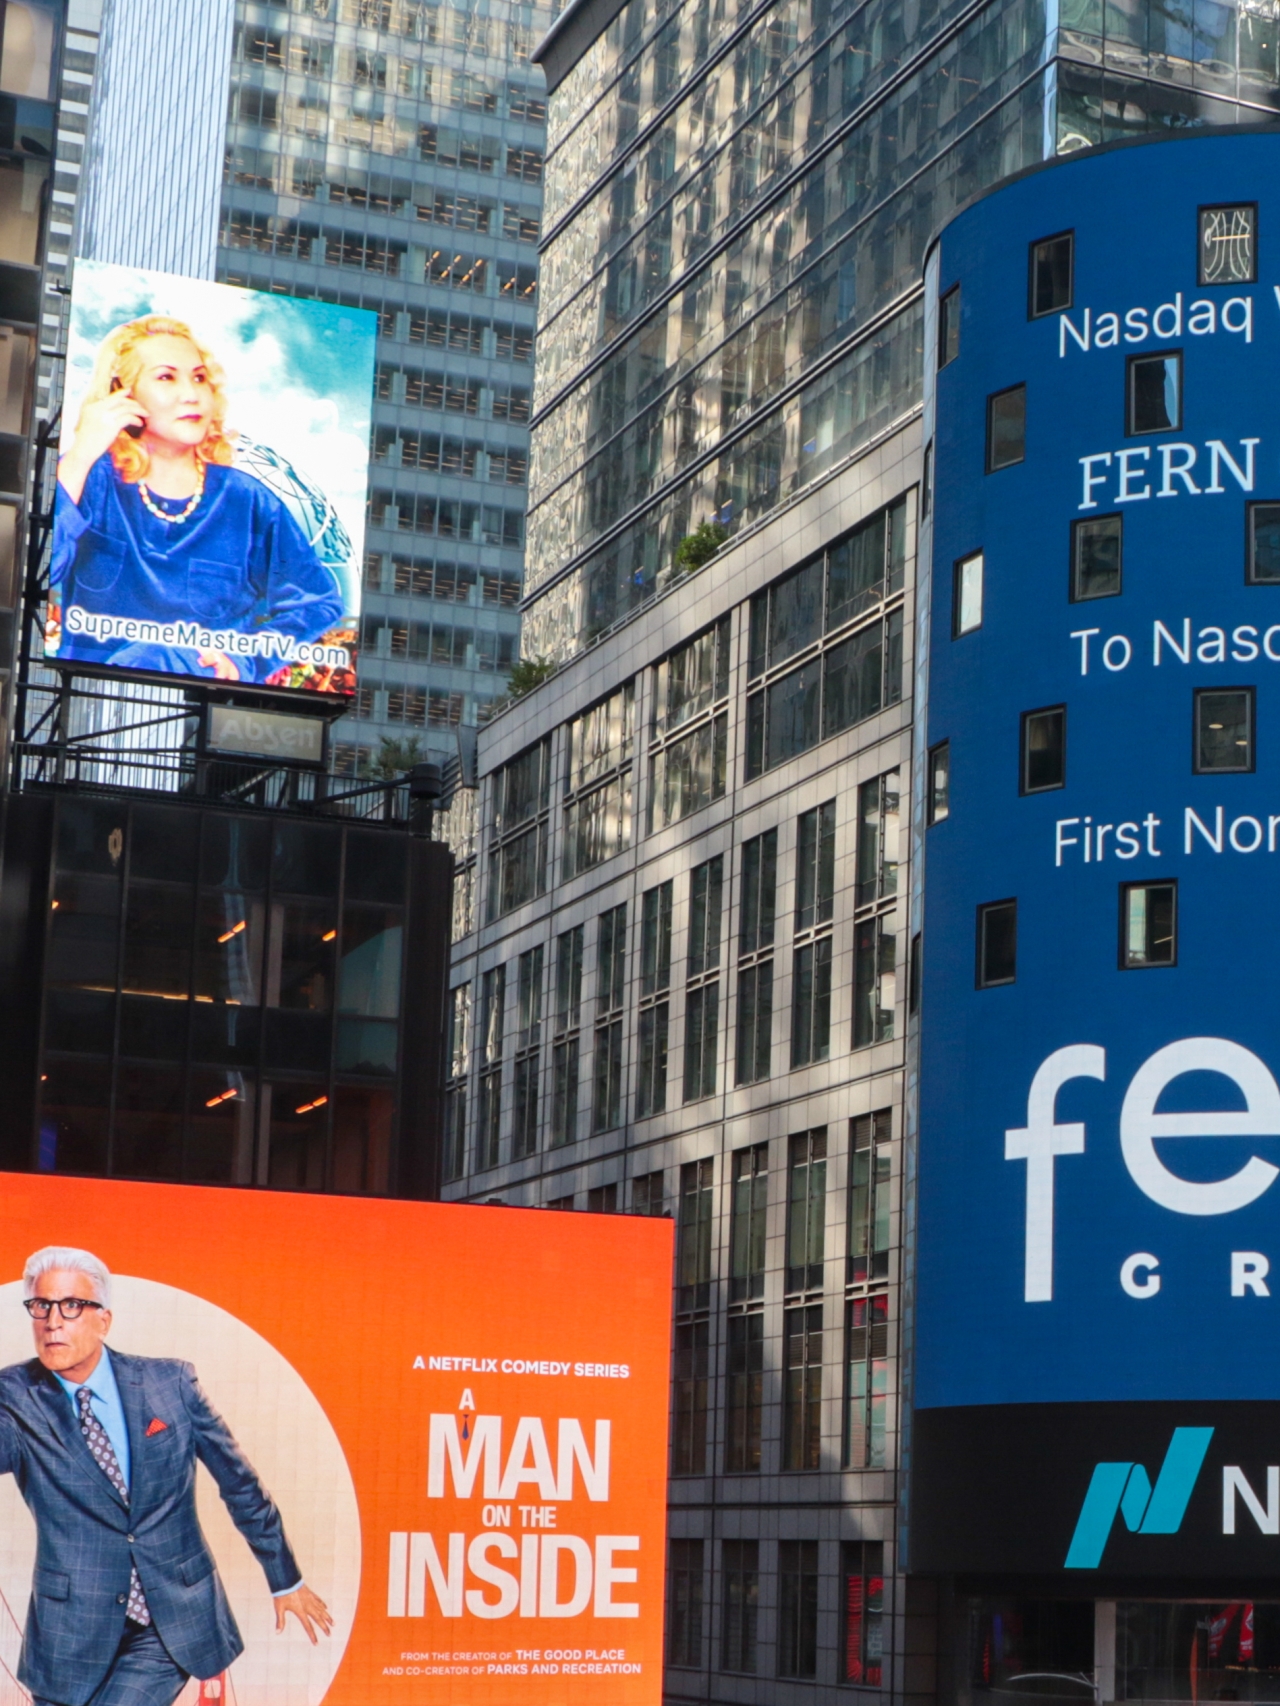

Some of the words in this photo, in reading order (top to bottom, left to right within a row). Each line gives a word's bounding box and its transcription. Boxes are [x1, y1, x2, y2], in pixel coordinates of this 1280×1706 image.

[1059, 292, 1252, 358] Nasdaq
[1078, 437, 1260, 510] FERN
[66, 607, 348, 667] SupremeMasterTV.com
[1070, 627, 1132, 676] To
[219, 715, 316, 750] Absen
[1055, 812, 1161, 867] First
[413, 1355, 426, 1370] A
[428, 1356, 498, 1373] NETFLIX
[501, 1359, 571, 1376] COMEDY
[574, 1363, 630, 1379] SERIES
[458, 1388, 476, 1410] A
[427, 1413, 610, 1502] MAN
[482, 1505, 511, 1528] ON
[518, 1505, 557, 1528] THE
[387, 1531, 640, 1620] INSIDE
[382, 1667, 404, 1676] AND
[405, 1667, 469, 1676] CO-CREATOR
[471, 1666, 485, 1675] OF
[487, 1663, 528, 1675] PARKS
[531, 1663, 559, 1675] AND
[562, 1663, 642, 1675] RECREATION
[400, 1652, 428, 1661] FROM
[431, 1652, 450, 1661] THE
[452, 1652, 497, 1661] CREATOR
[499, 1652, 512, 1661] OF
[516, 1649, 540, 1661] THE
[543, 1649, 582, 1661] GOOD
[585, 1649, 625, 1661] PLACE
